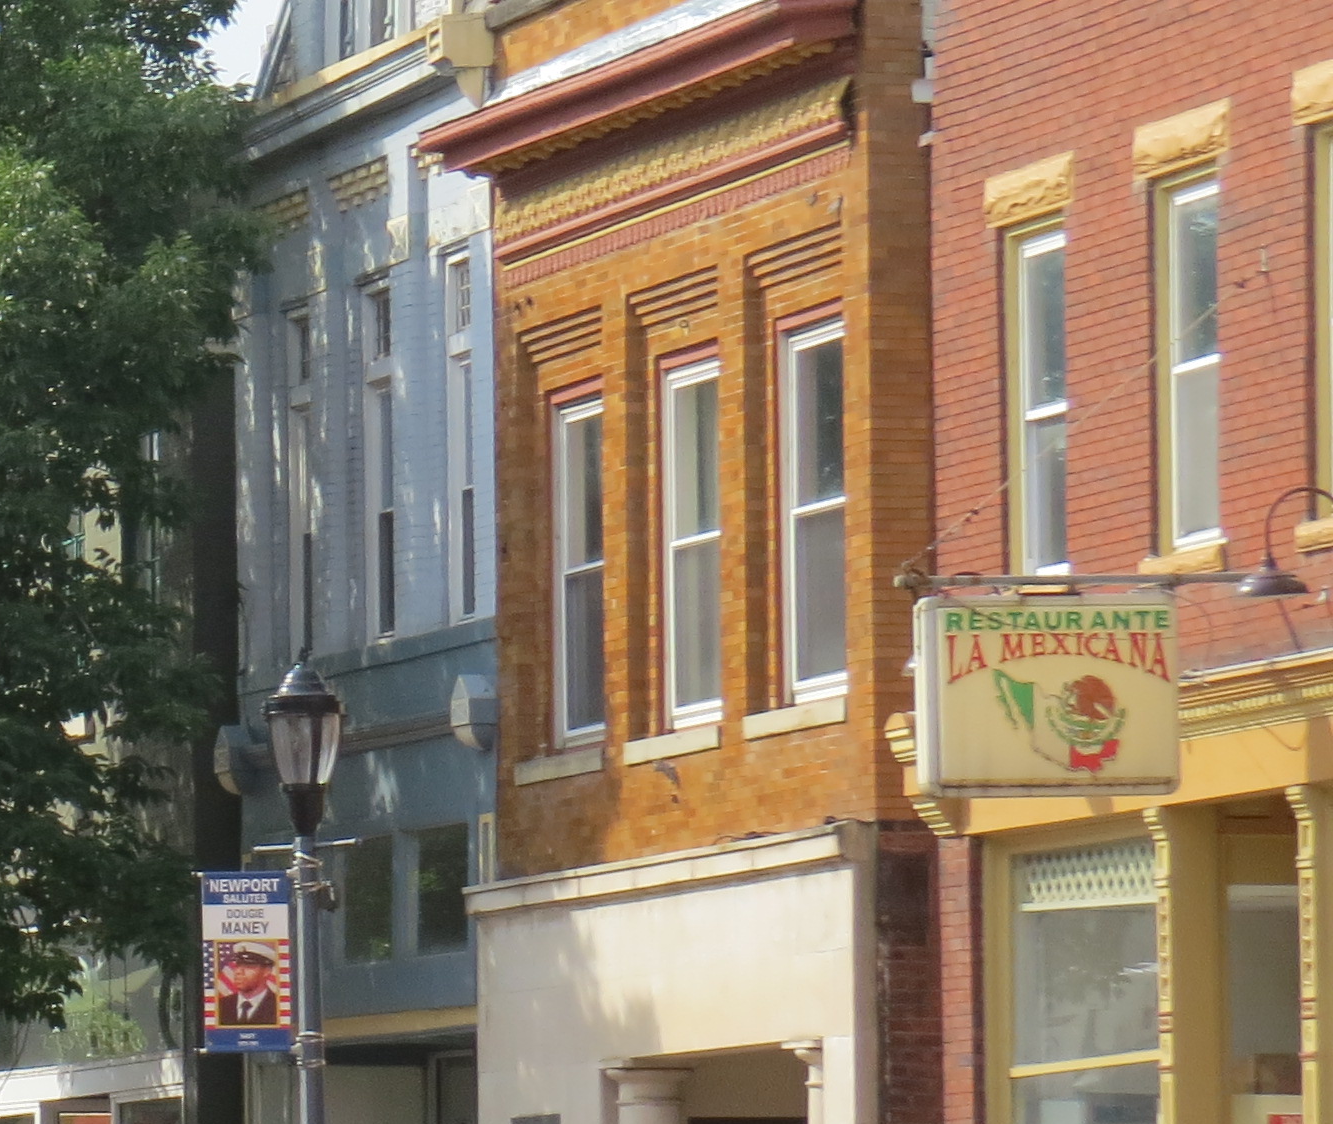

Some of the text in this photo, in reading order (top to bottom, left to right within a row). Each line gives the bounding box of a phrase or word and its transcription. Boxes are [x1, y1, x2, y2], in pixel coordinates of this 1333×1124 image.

[945, 610, 1170, 631] RESTAURANTE
[946, 632, 1170, 684] LA MEXICANA
[209, 879, 280, 892] NEWPORT
[223, 894, 268, 903] SALUTES
[221, 921, 269, 934] MANEY
